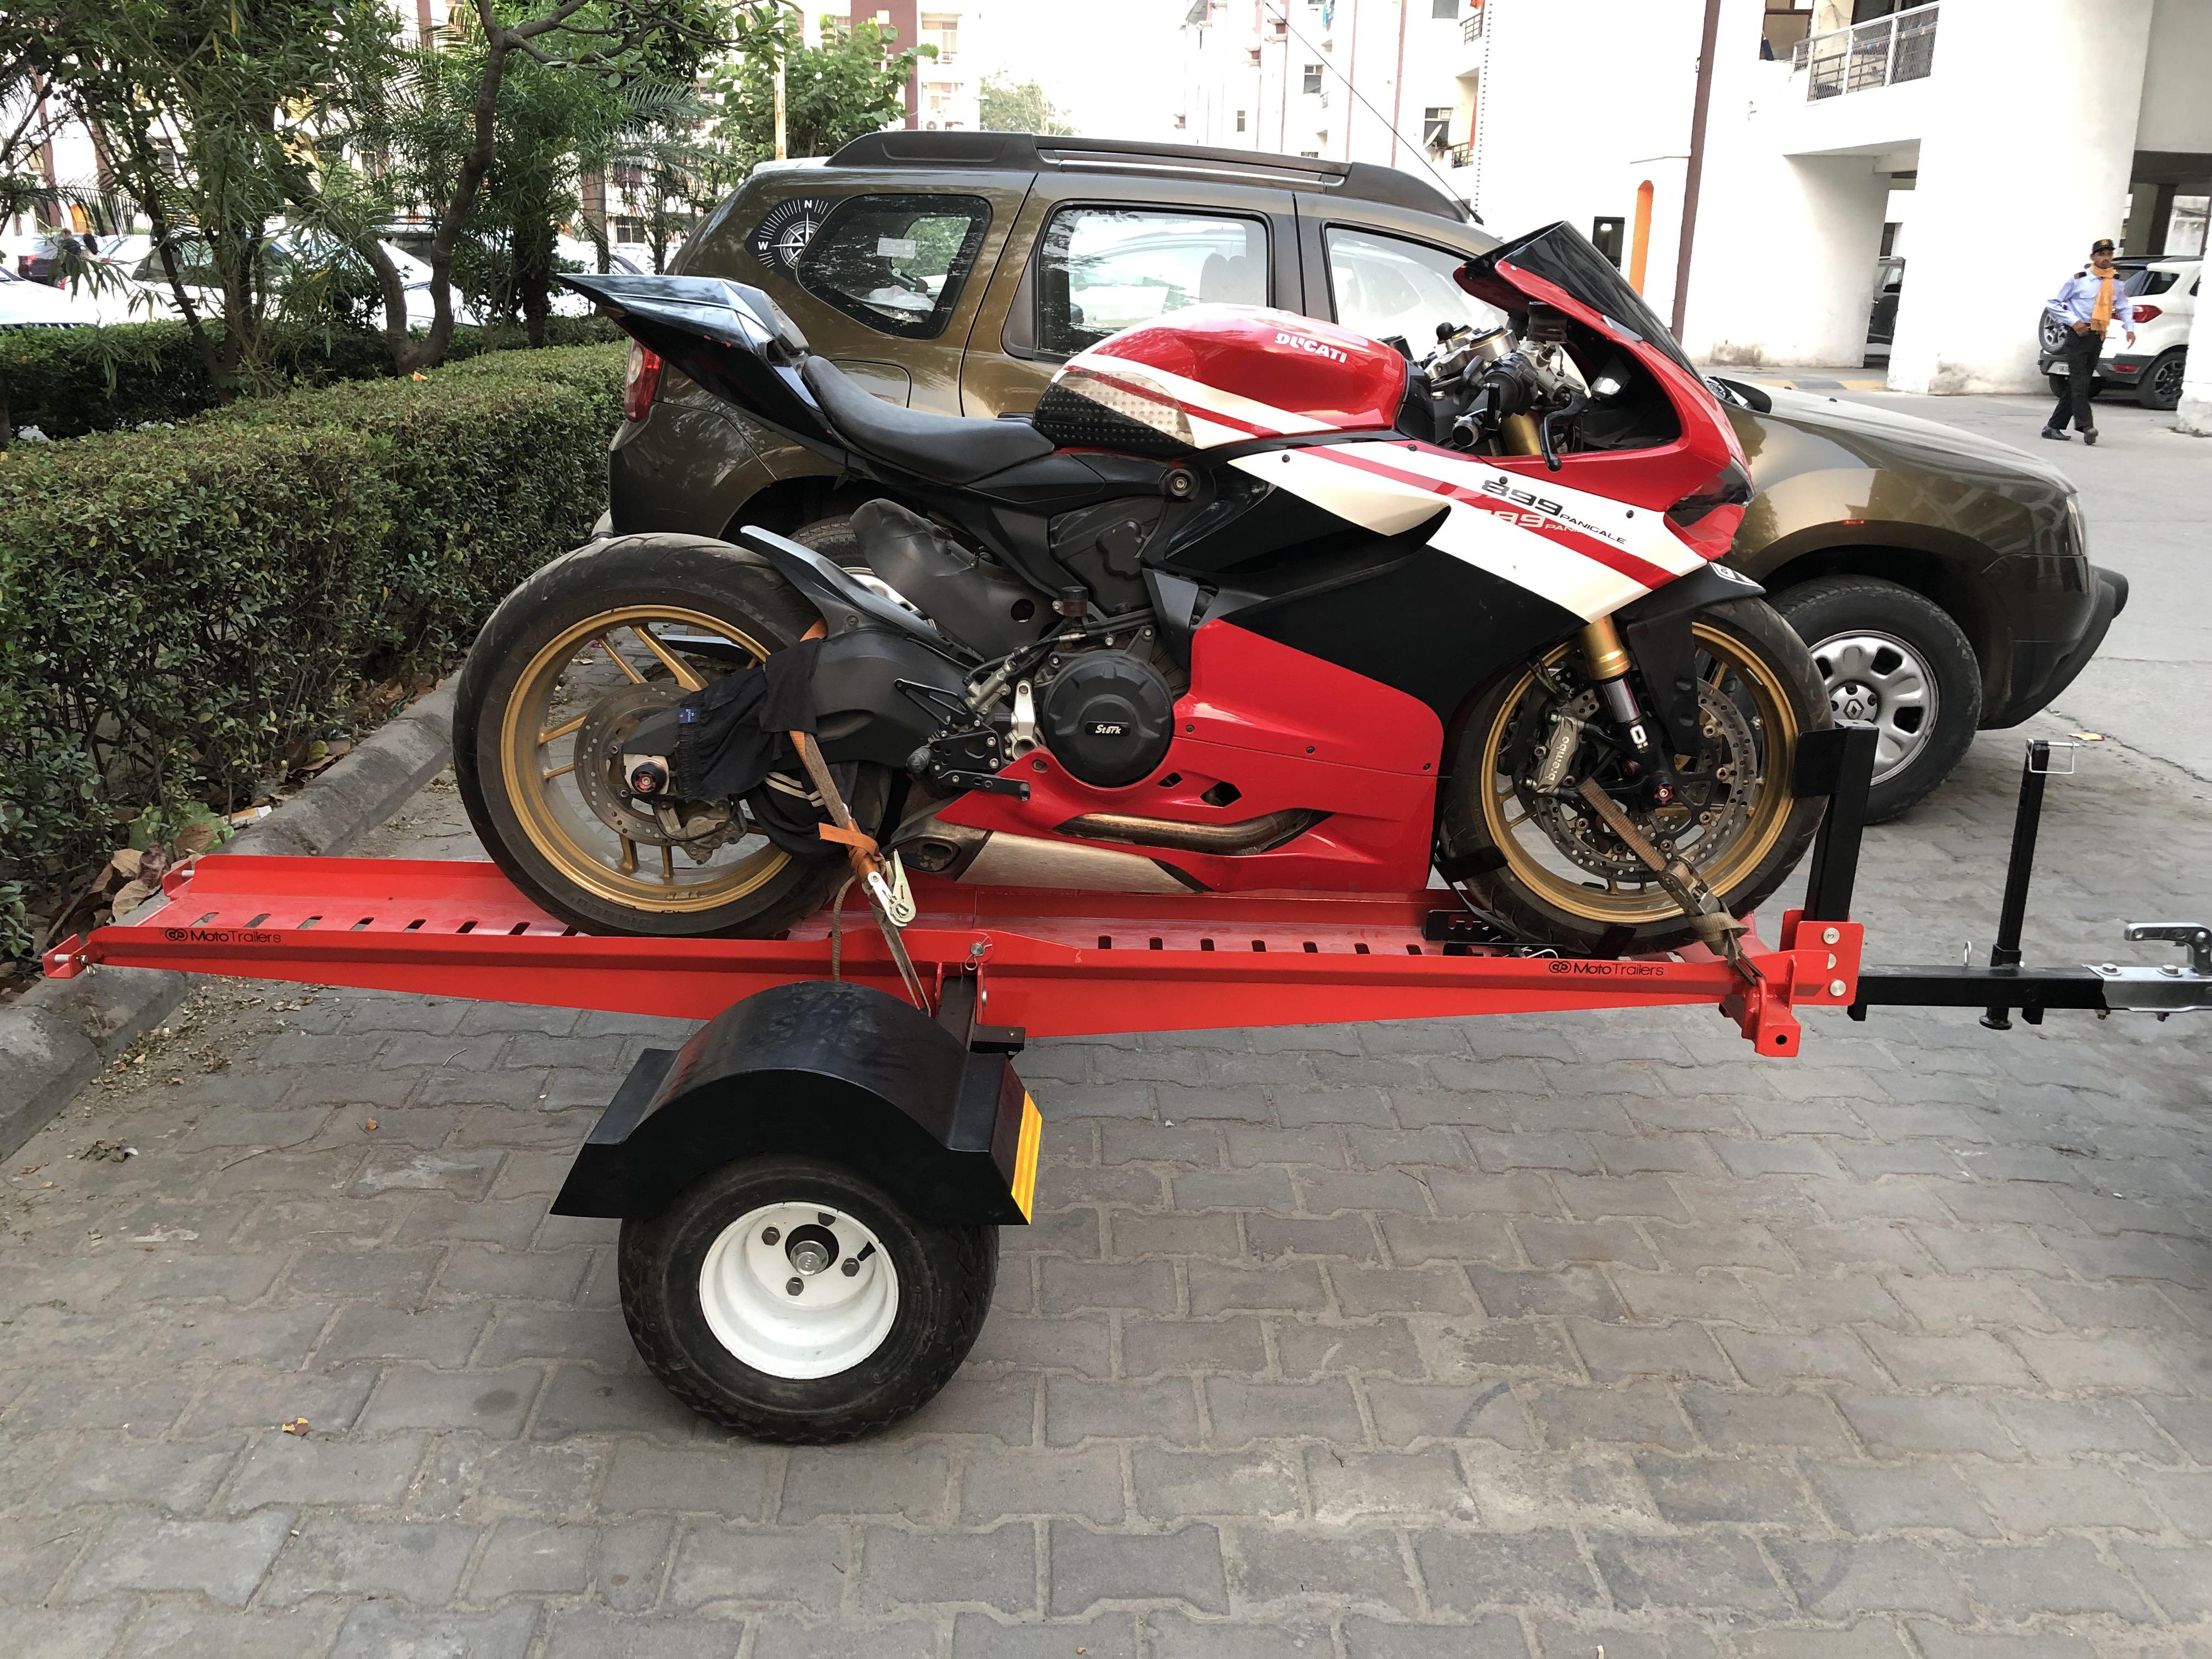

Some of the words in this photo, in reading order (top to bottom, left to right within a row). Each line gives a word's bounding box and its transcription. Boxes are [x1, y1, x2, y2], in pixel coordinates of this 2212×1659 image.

[804, 200, 812, 208] N
[758, 241, 769, 250] W
[1274, 332, 1347, 363] DUCATI
[1481, 479, 1564, 516] 899
[1560, 514, 1627, 544] PANIGALE
[1095, 724, 1121, 734] Stark
[1545, 736, 1570, 781] brembo
[191, 930, 281, 943] MotoTrailers
[1573, 962, 1664, 976] MotoTrailers
